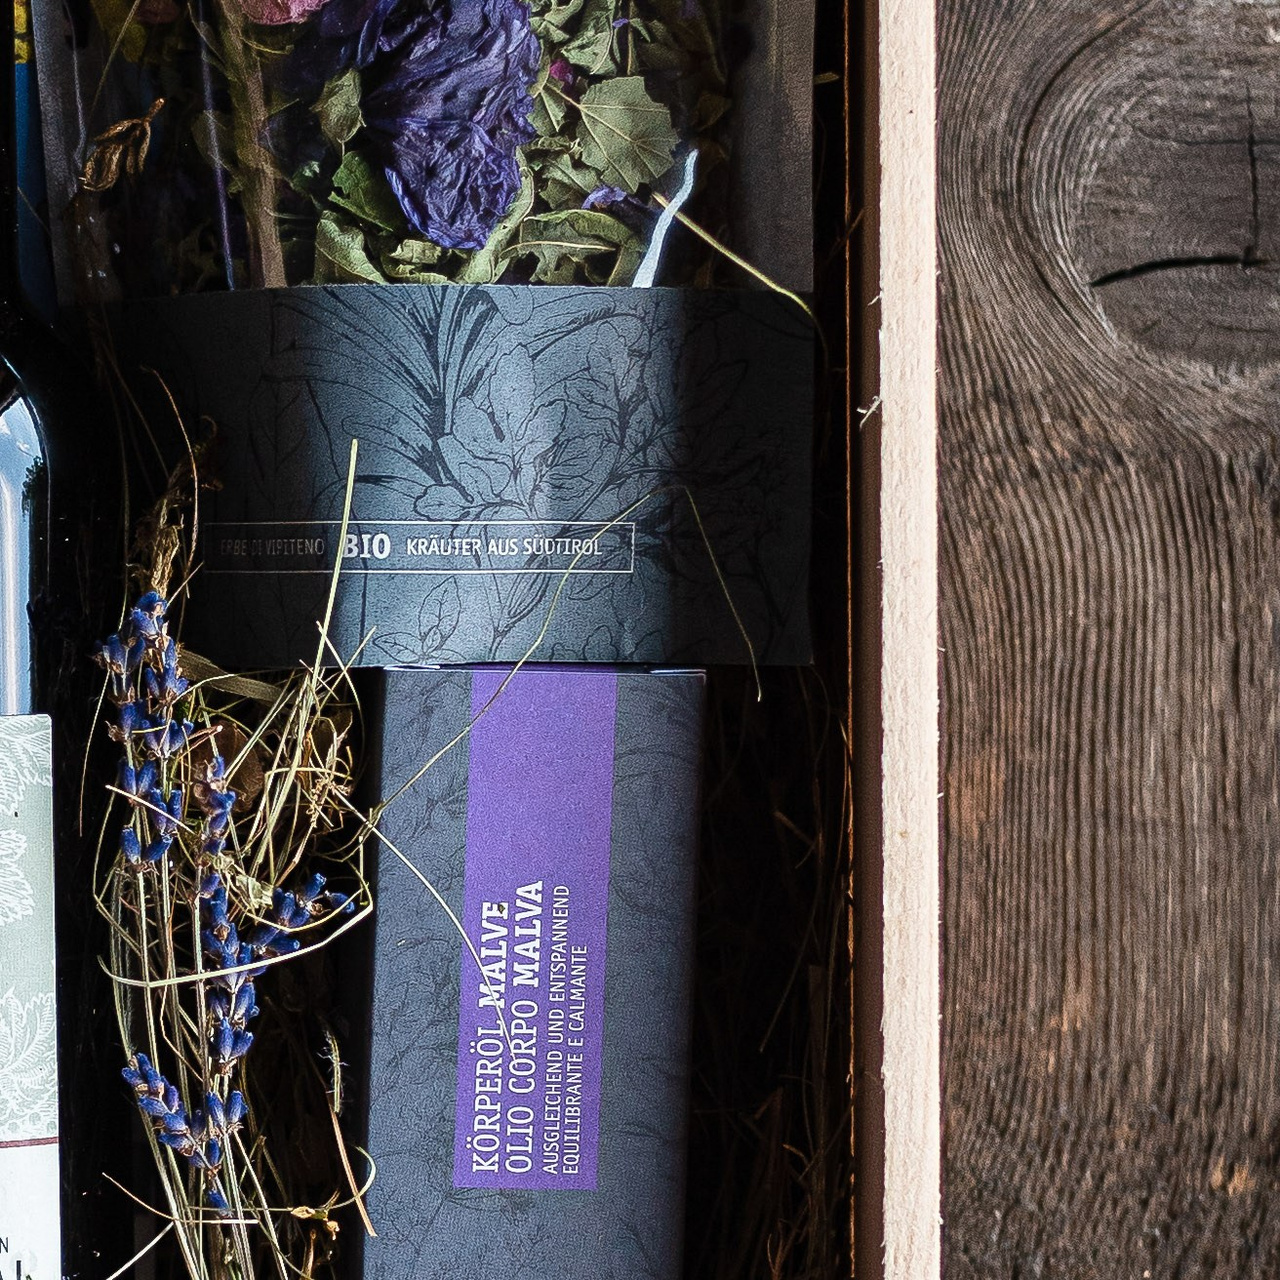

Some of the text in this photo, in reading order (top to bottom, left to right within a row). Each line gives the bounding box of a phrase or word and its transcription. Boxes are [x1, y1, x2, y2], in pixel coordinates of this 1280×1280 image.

[342, 534, 390, 559] BIO
[407, 534, 481, 556] KRÄUTER
[487, 539, 518, 556] AUS
[523, 534, 602, 556] SÜDTIROL
[465, 901, 509, 1173] KÖRPERÖL MALVE
[506, 881, 544, 1173] OLIO CORPO MALVA
[541, 885, 571, 1175] AUSGLEICHEND UND ENTSPANNEND
[570, 945, 589, 1030] CALMANTE
[562, 1052, 583, 1175] EQUILIBRANTE
